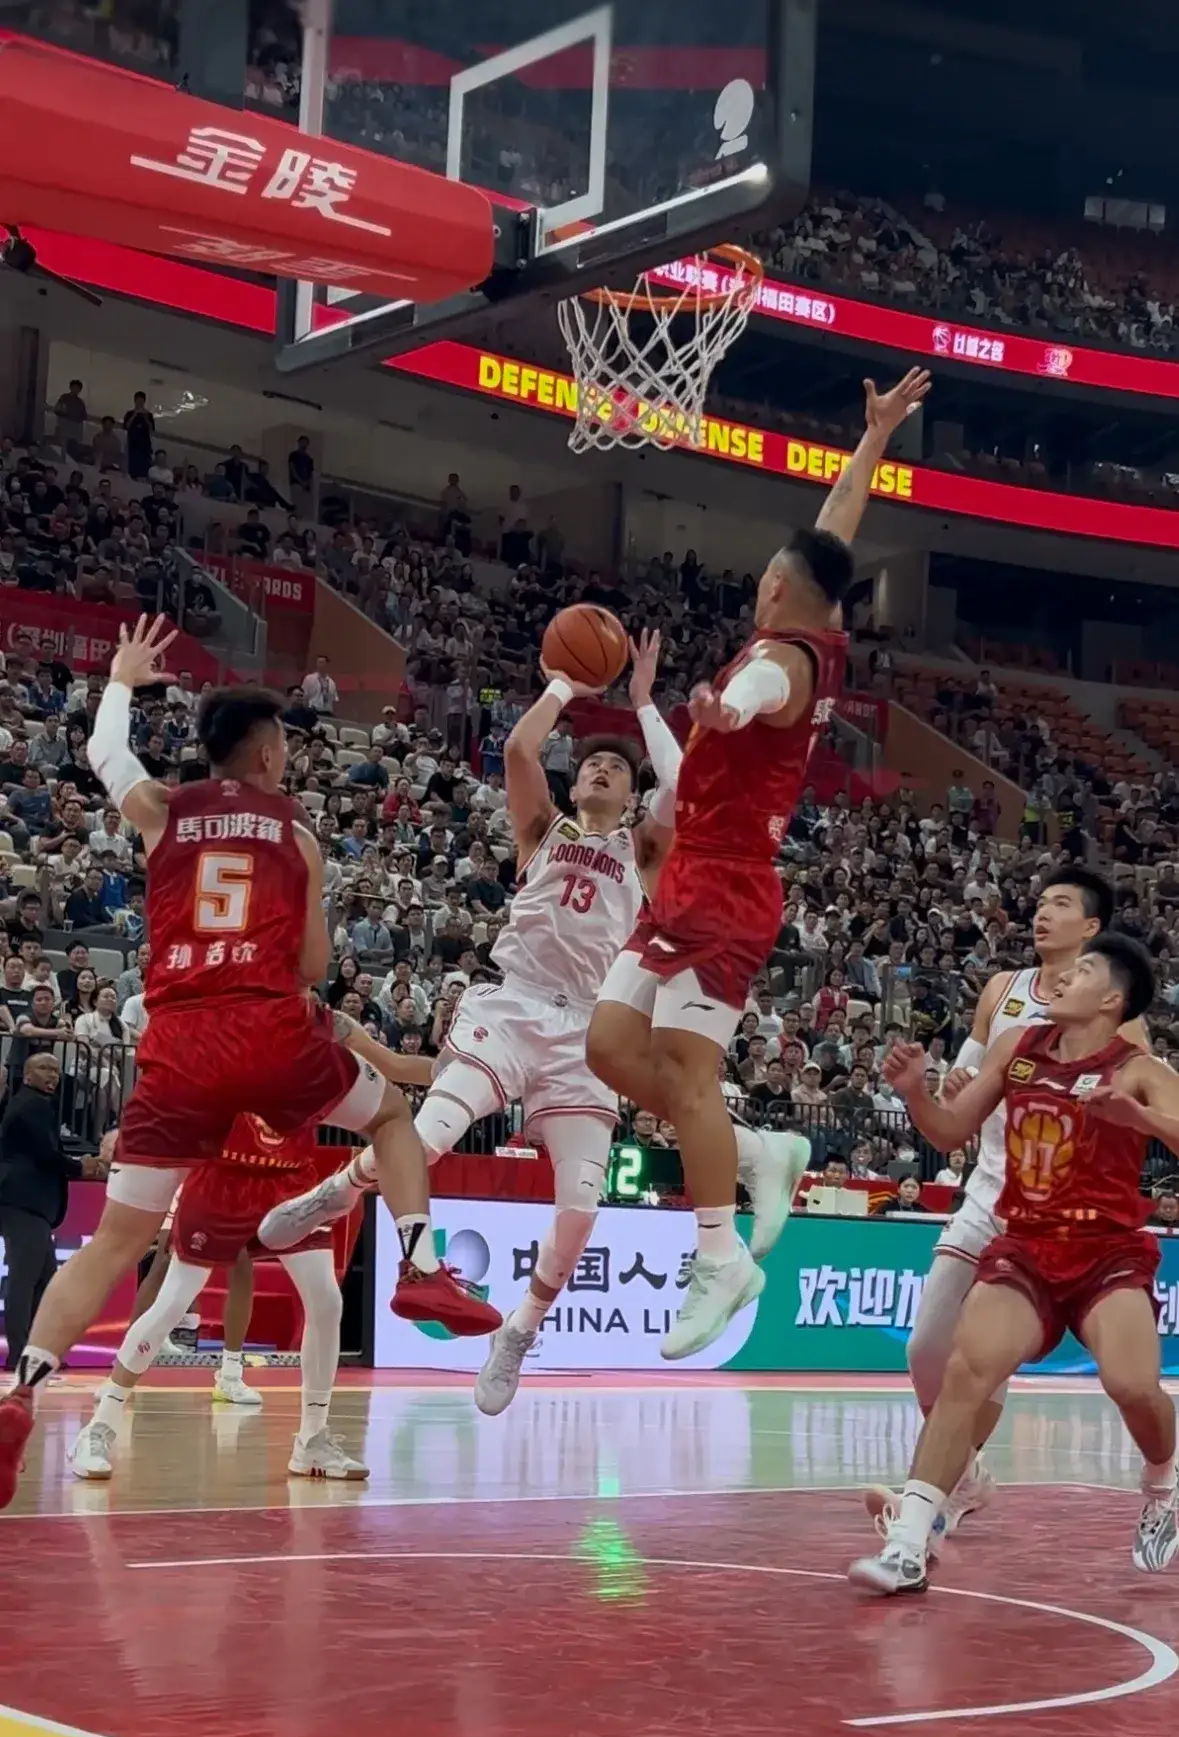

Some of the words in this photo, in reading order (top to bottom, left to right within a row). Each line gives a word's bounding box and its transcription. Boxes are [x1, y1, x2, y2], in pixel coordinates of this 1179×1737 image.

[130, 126, 392, 237] 金陵
[547, 843, 625, 884] LOONGIONS
[193, 852, 254, 932] 5
[559, 873, 597, 914] 13
[538, 1307, 630, 1334] HINA
